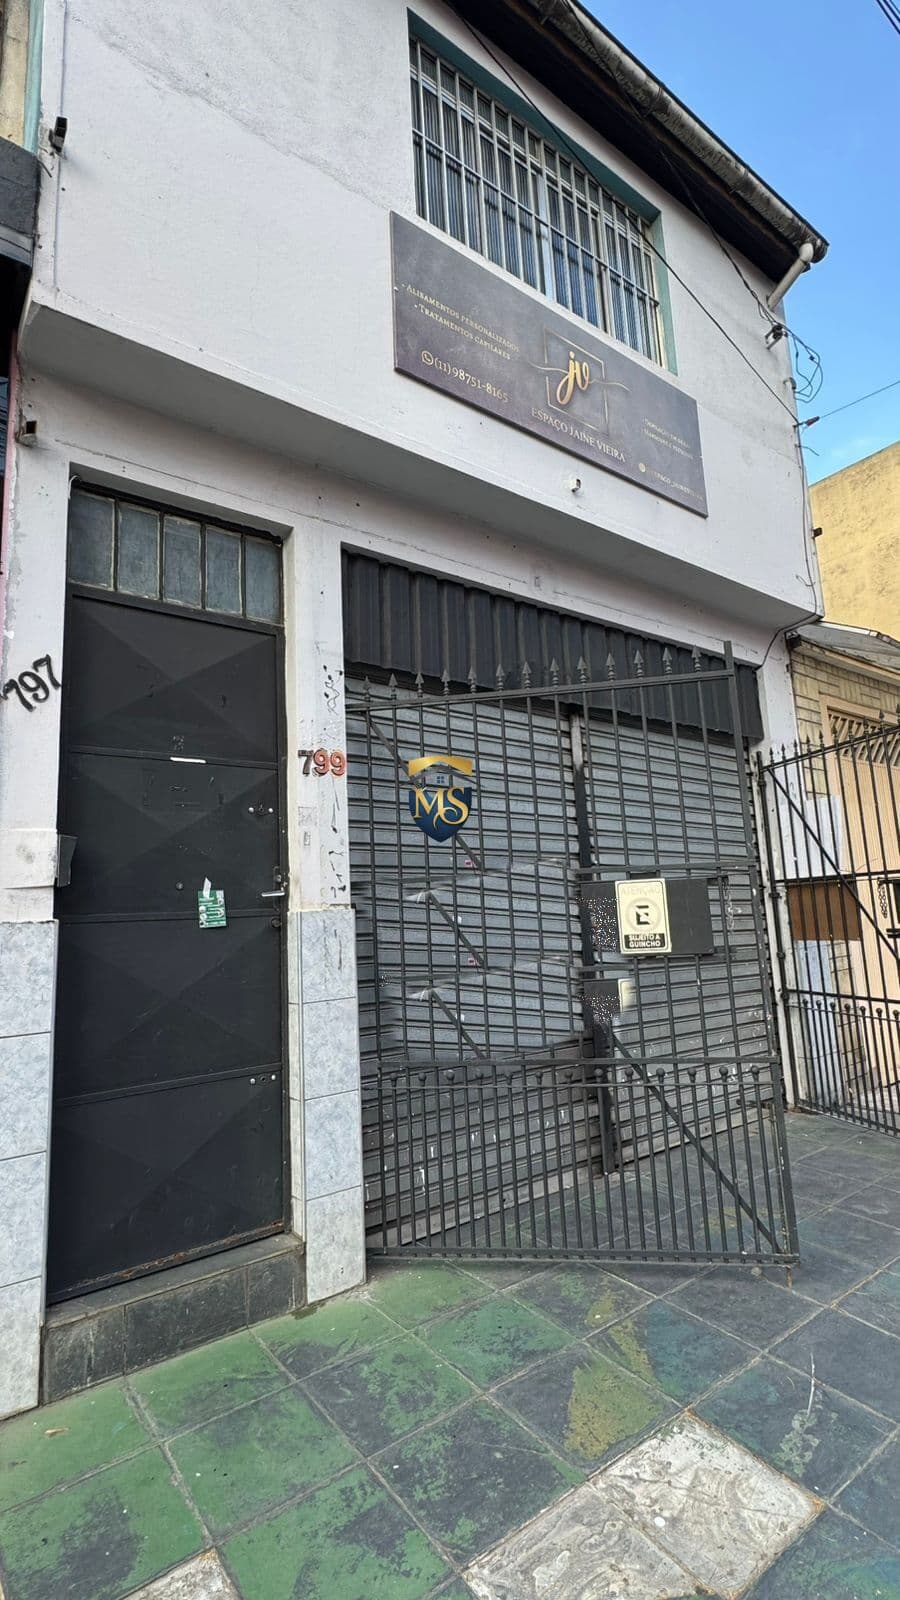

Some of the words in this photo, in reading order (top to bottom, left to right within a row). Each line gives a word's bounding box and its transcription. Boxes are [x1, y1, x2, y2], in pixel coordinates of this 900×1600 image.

[406, 284, 460, 319] ALISAMENTOS
[418, 303, 474, 341] TRATAMENTOS
[531, 407, 568, 433] ESPAÇO
[569, 425, 595, 447] JAINE
[597, 440, 626, 463] VIEIRA
[2, 653, 62, 713] 797
[297, 748, 348, 777] 799
[629, 940, 661, 948] GUINCHO
